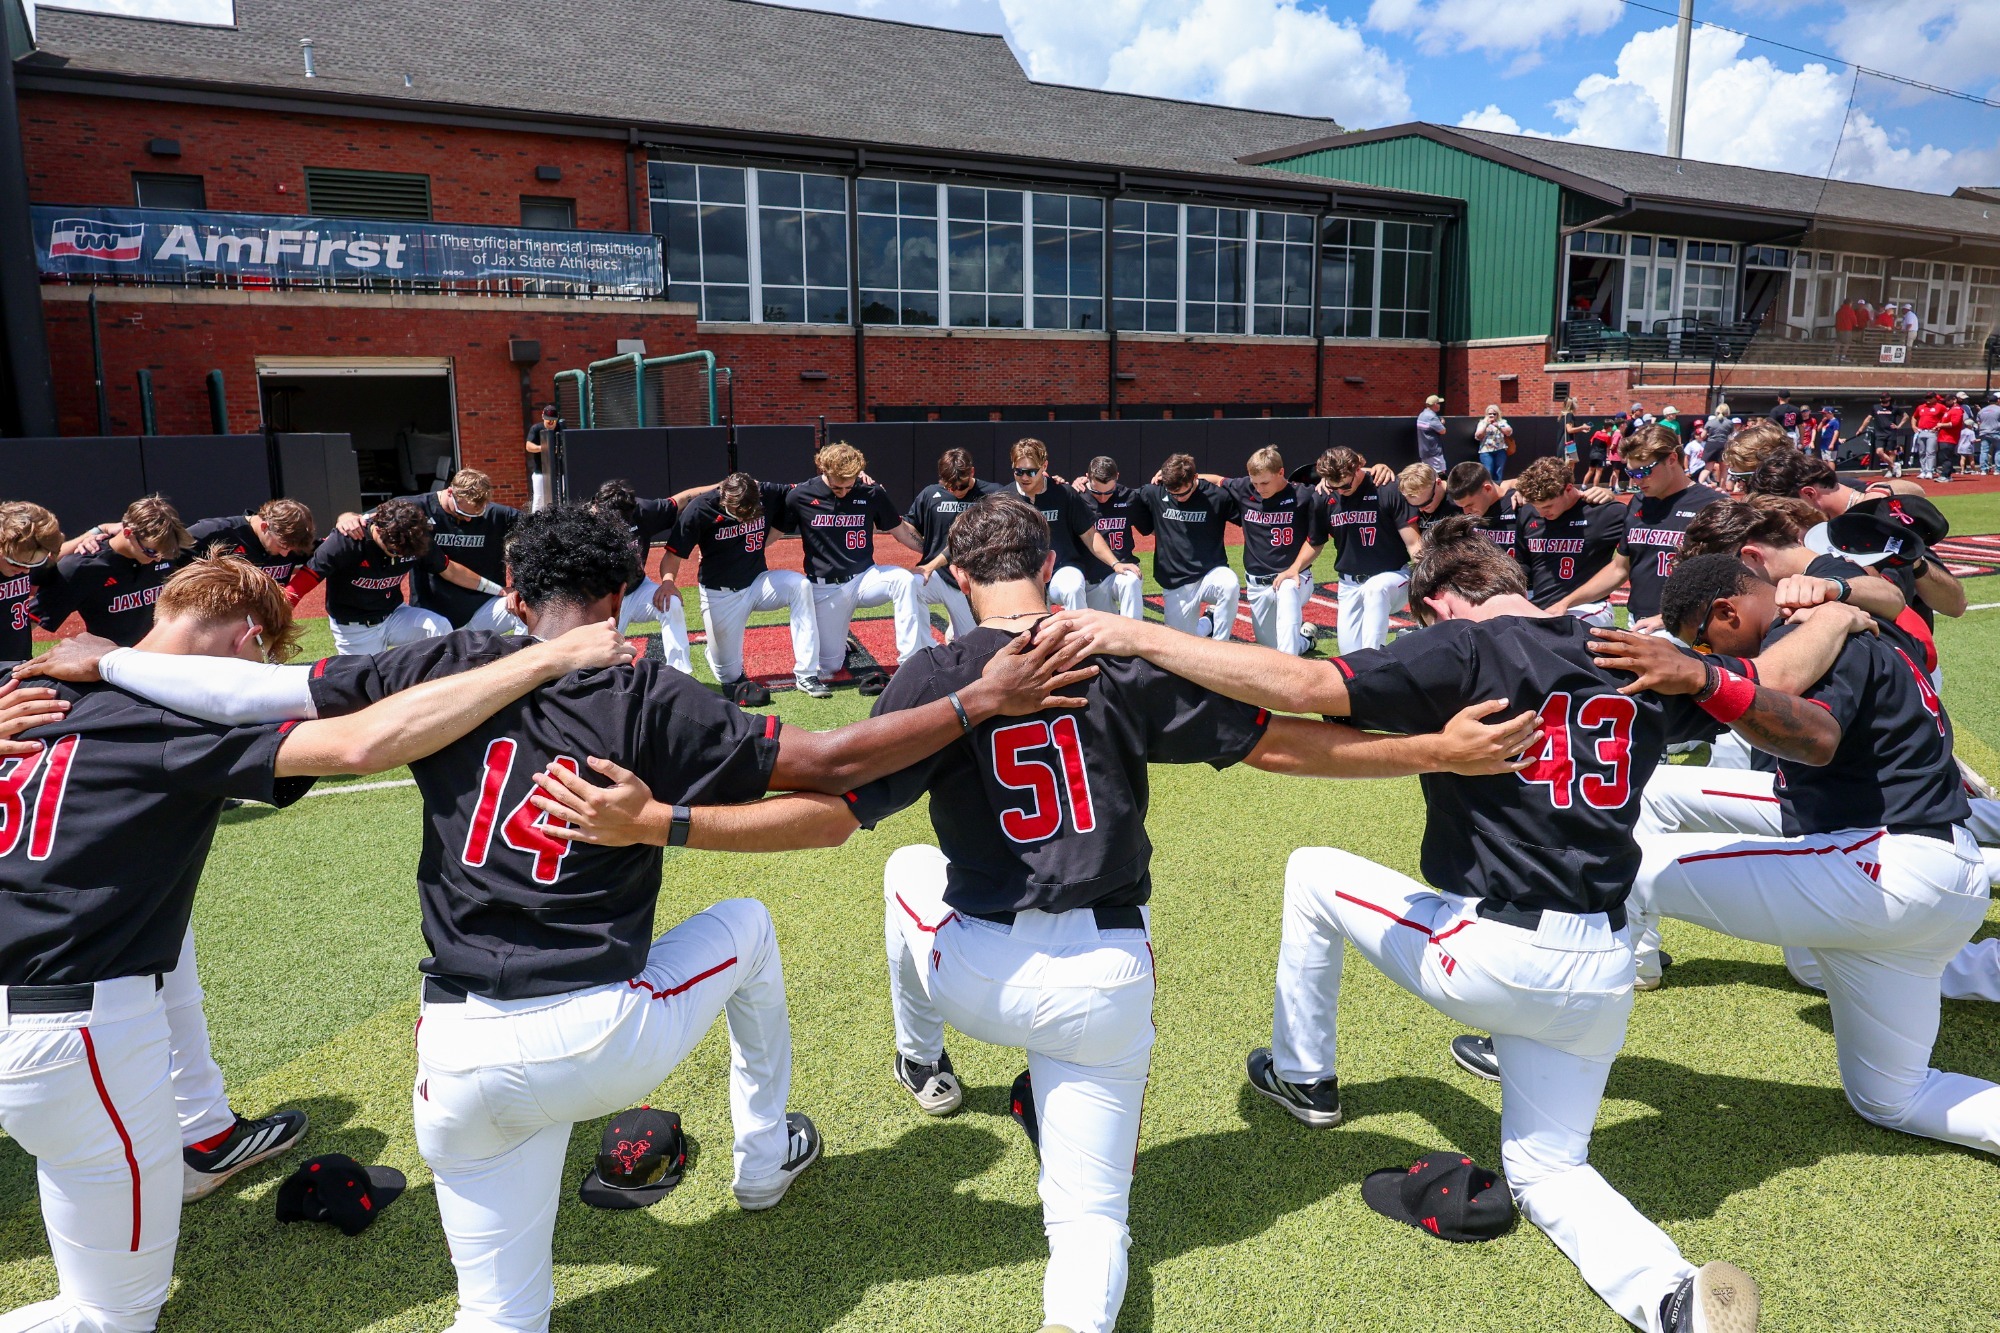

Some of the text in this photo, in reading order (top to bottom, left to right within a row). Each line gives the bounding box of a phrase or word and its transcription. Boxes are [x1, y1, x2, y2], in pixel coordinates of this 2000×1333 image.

[153, 225, 406, 269] AmFirst
[440, 233, 651, 255] The official financial institution
[472, 253, 621, 270] of Jax State Athletics.
[936, 501, 958, 513] JAX
[1162, 508, 1208, 523] JAX STATE
[810, 514, 866, 527] JAX STATE
[1097, 517, 1127, 530] STATE
[1243, 509, 1294, 525] JAX STATE
[1330, 511, 1378, 527] JAX STATE
[715, 516, 766, 540] JAX STATE
[1270, 527, 1294, 546] 38
[1359, 527, 1377, 546] 17
[1488, 530, 1516, 545] STATE
[1627, 528, 1686, 547] JAX STATE
[434, 533, 485, 547] JAX STATE
[745, 531, 765, 552] 55
[845, 530, 867, 550] 66
[1109, 532, 1124, 550] 15
[1547, 538, 1585, 553] STATE
[1559, 556, 1575, 580] 8
[351, 577, 382, 590] JAX
[108, 590, 143, 613] JAX
[1514, 691, 1638, 809] 43
[991, 715, 1096, 843] 51
[461, 737, 580, 885] 14
